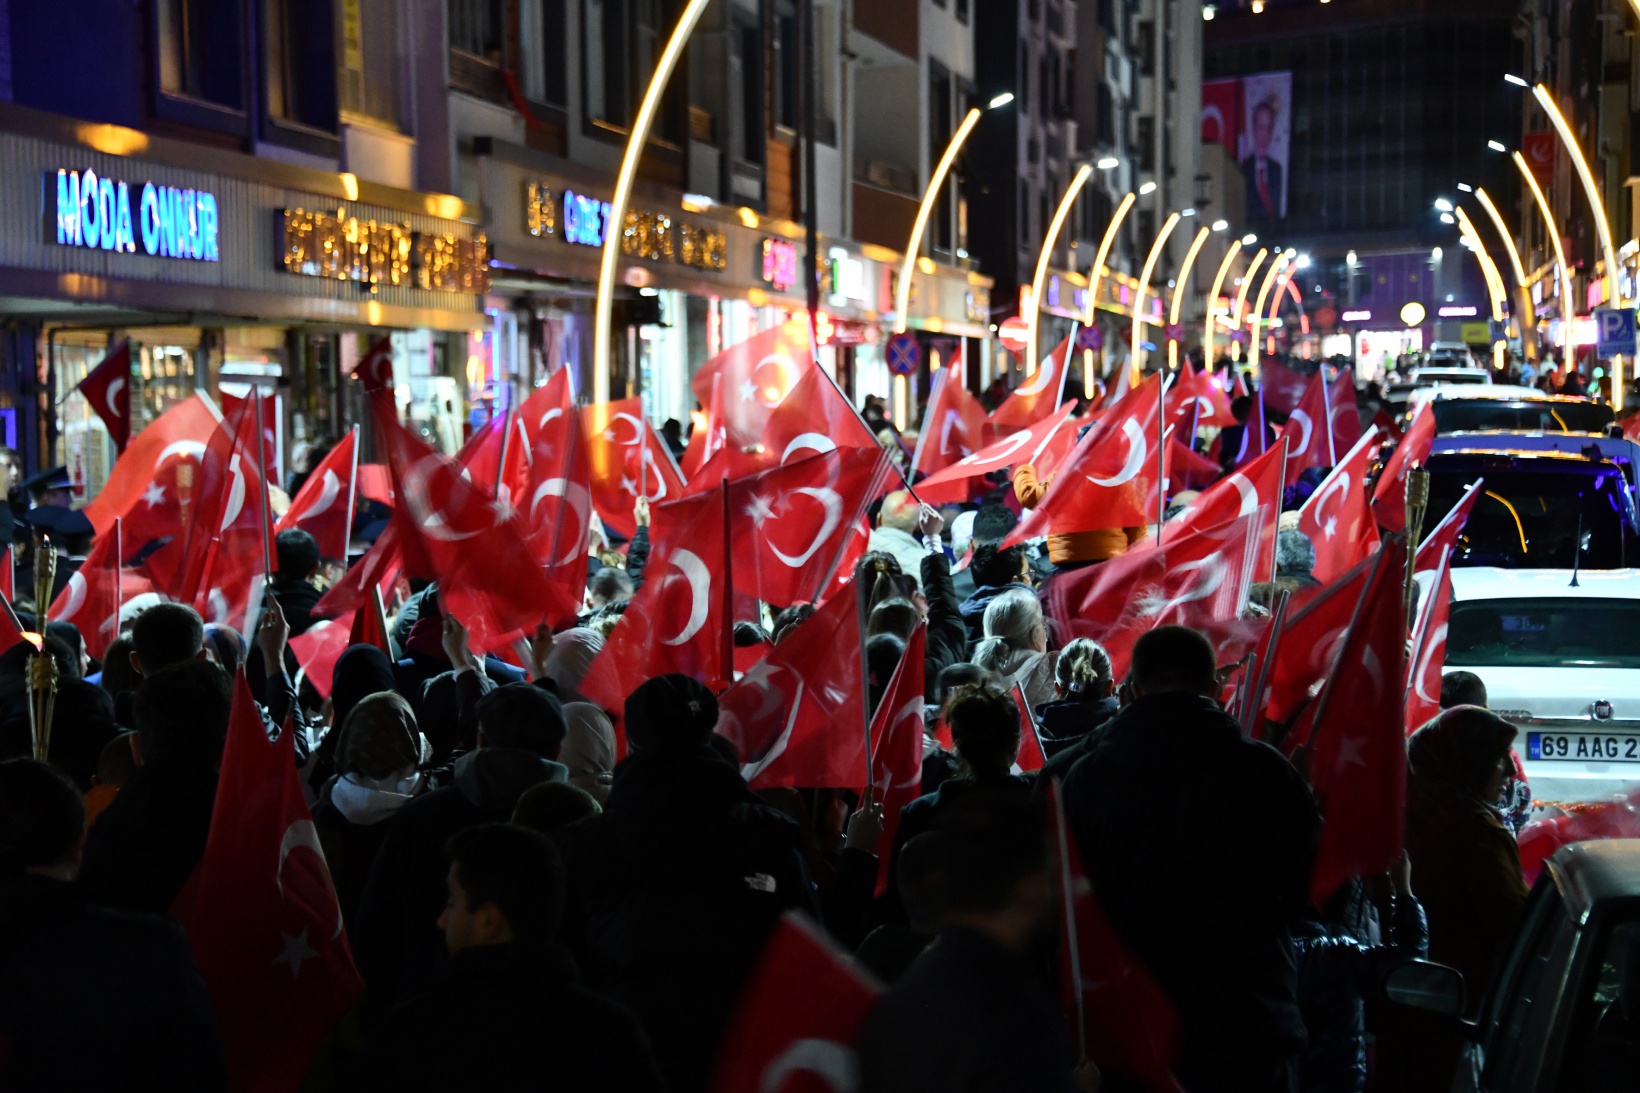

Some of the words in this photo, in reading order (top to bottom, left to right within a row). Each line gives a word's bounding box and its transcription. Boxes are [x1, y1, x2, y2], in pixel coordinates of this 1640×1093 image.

[57, 168, 135, 253] MODA
[1602, 312, 1623, 340] P
[1531, 747, 1540, 755] TR
[1542, 736, 1568, 756] 69
[1577, 737, 1618, 758] AAG
[1625, 738, 1640, 758] 2
